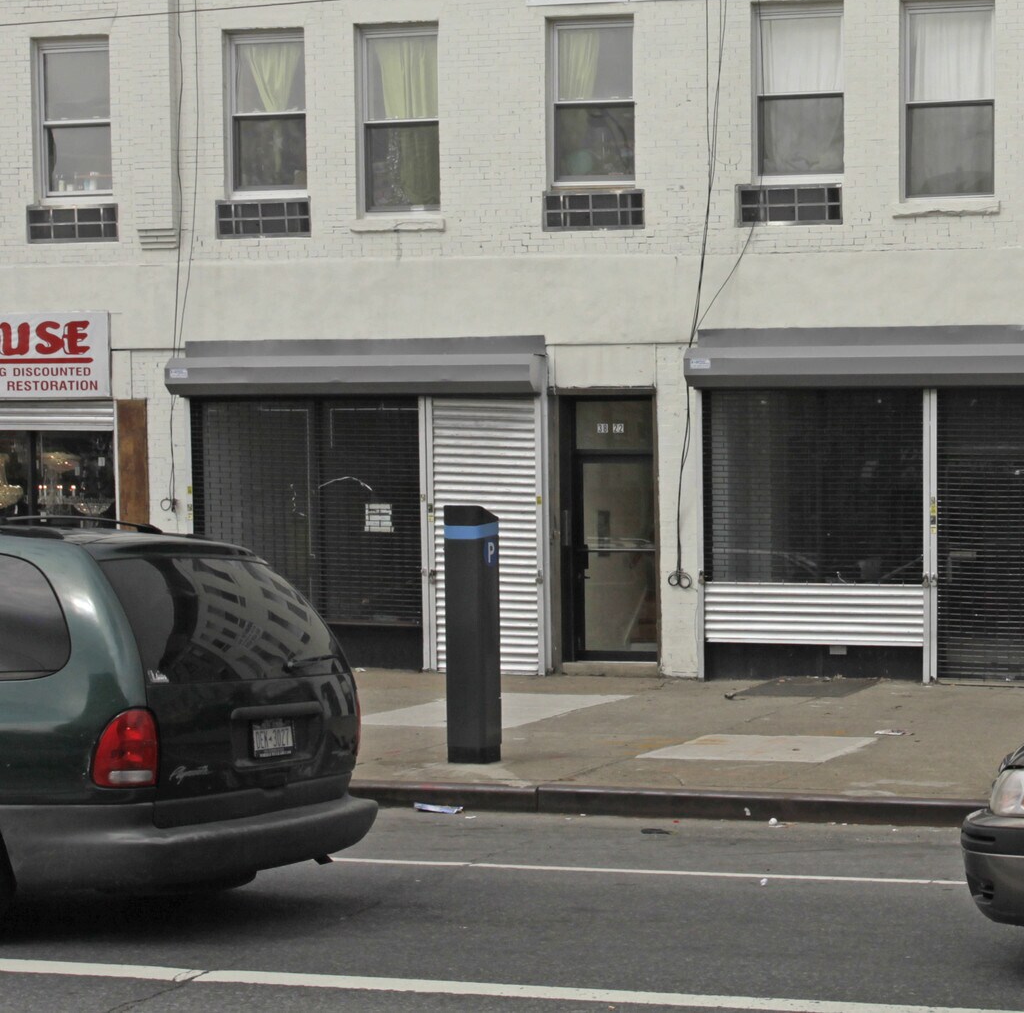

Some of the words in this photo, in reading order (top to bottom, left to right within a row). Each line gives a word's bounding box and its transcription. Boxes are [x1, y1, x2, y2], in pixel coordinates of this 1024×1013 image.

[13, 367, 92, 377] DISCOUNTED
[7, 380, 98, 391] RESTORATION
[487, 541, 495, 563] P
